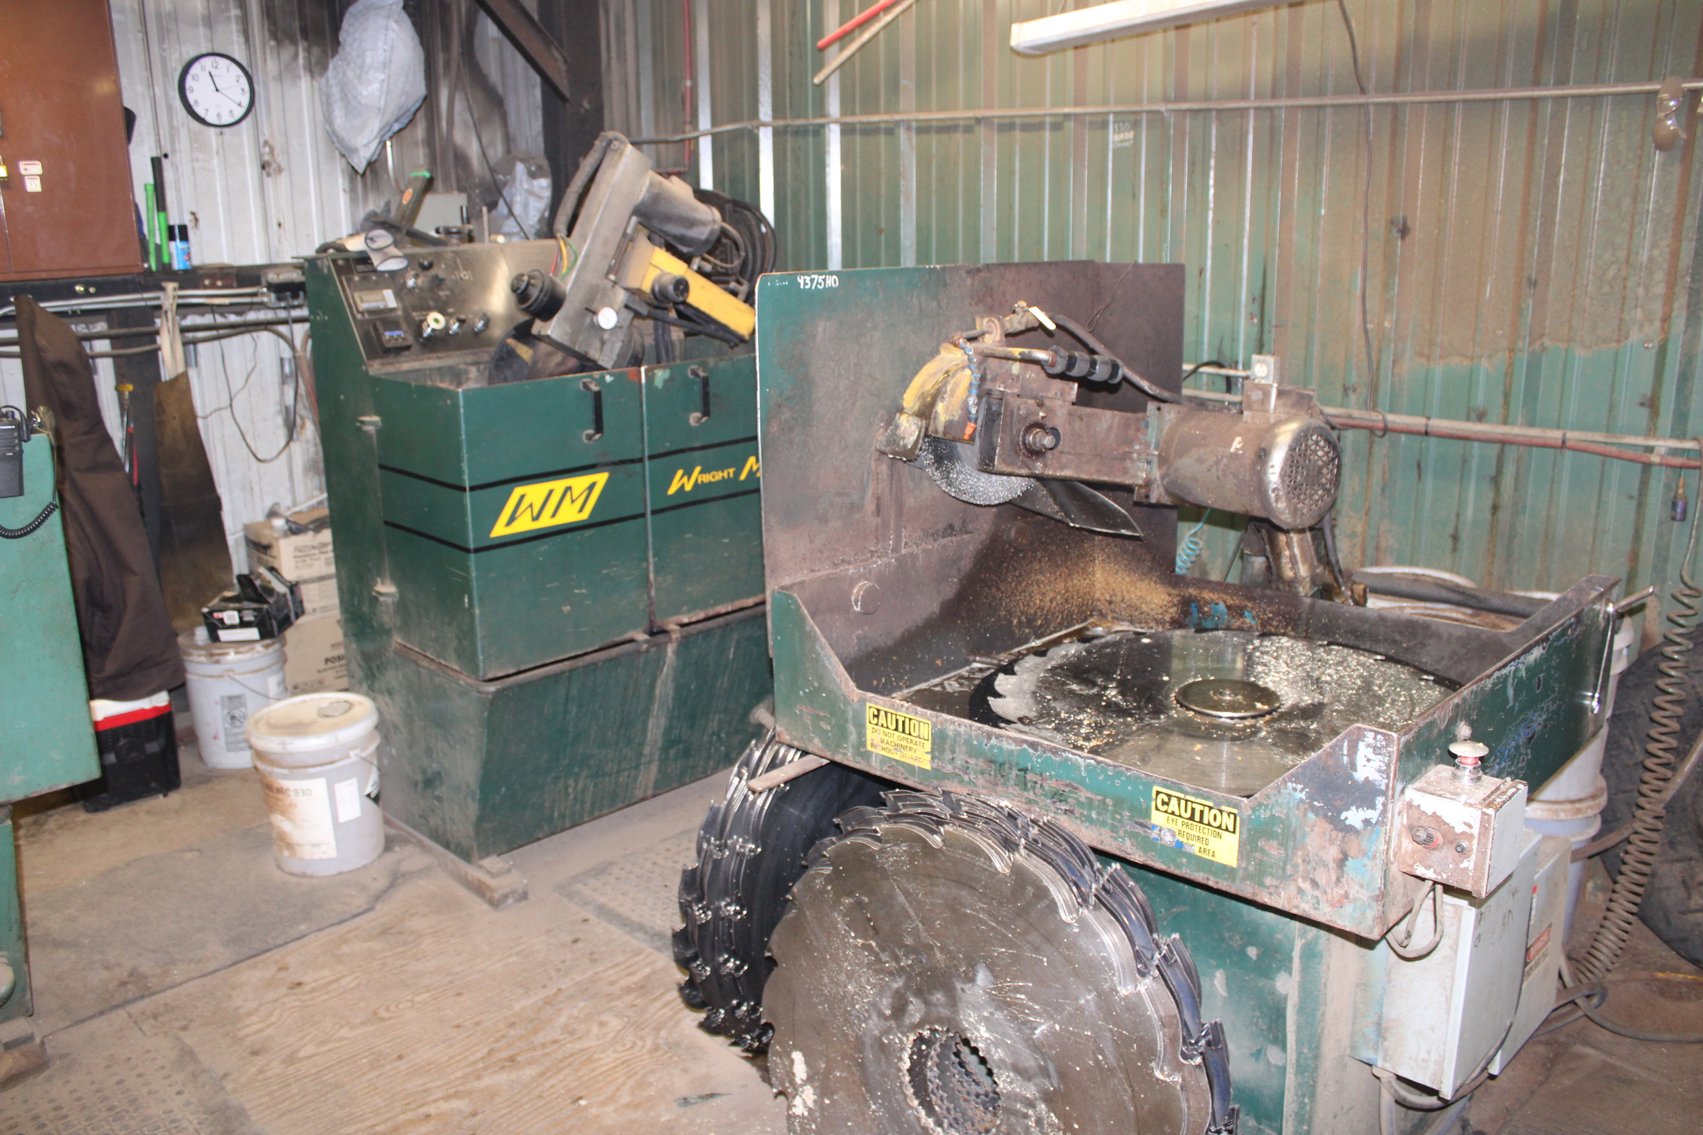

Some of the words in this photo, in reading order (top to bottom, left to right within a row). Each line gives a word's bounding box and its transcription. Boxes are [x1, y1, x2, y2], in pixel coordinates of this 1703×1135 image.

[200, 64, 206, 72] 11
[211, 60, 219, 69] 12
[191, 73, 199, 82] 10
[188, 85, 194, 93] 9
[739, 456, 761, 481] M
[869, 707, 929, 741] CAUTION
[871, 727, 881, 735] DO
[882, 730, 895, 738] NOT
[897, 735, 926, 749] OPERATE
[1156, 793, 1235, 832] CAUTION
[1166, 816, 1178, 826] EYE
[1181, 821, 1222, 839] PROTECTION
[1177, 829, 1210, 846] REQUIRED
[1198, 846, 1216, 858] AREA
